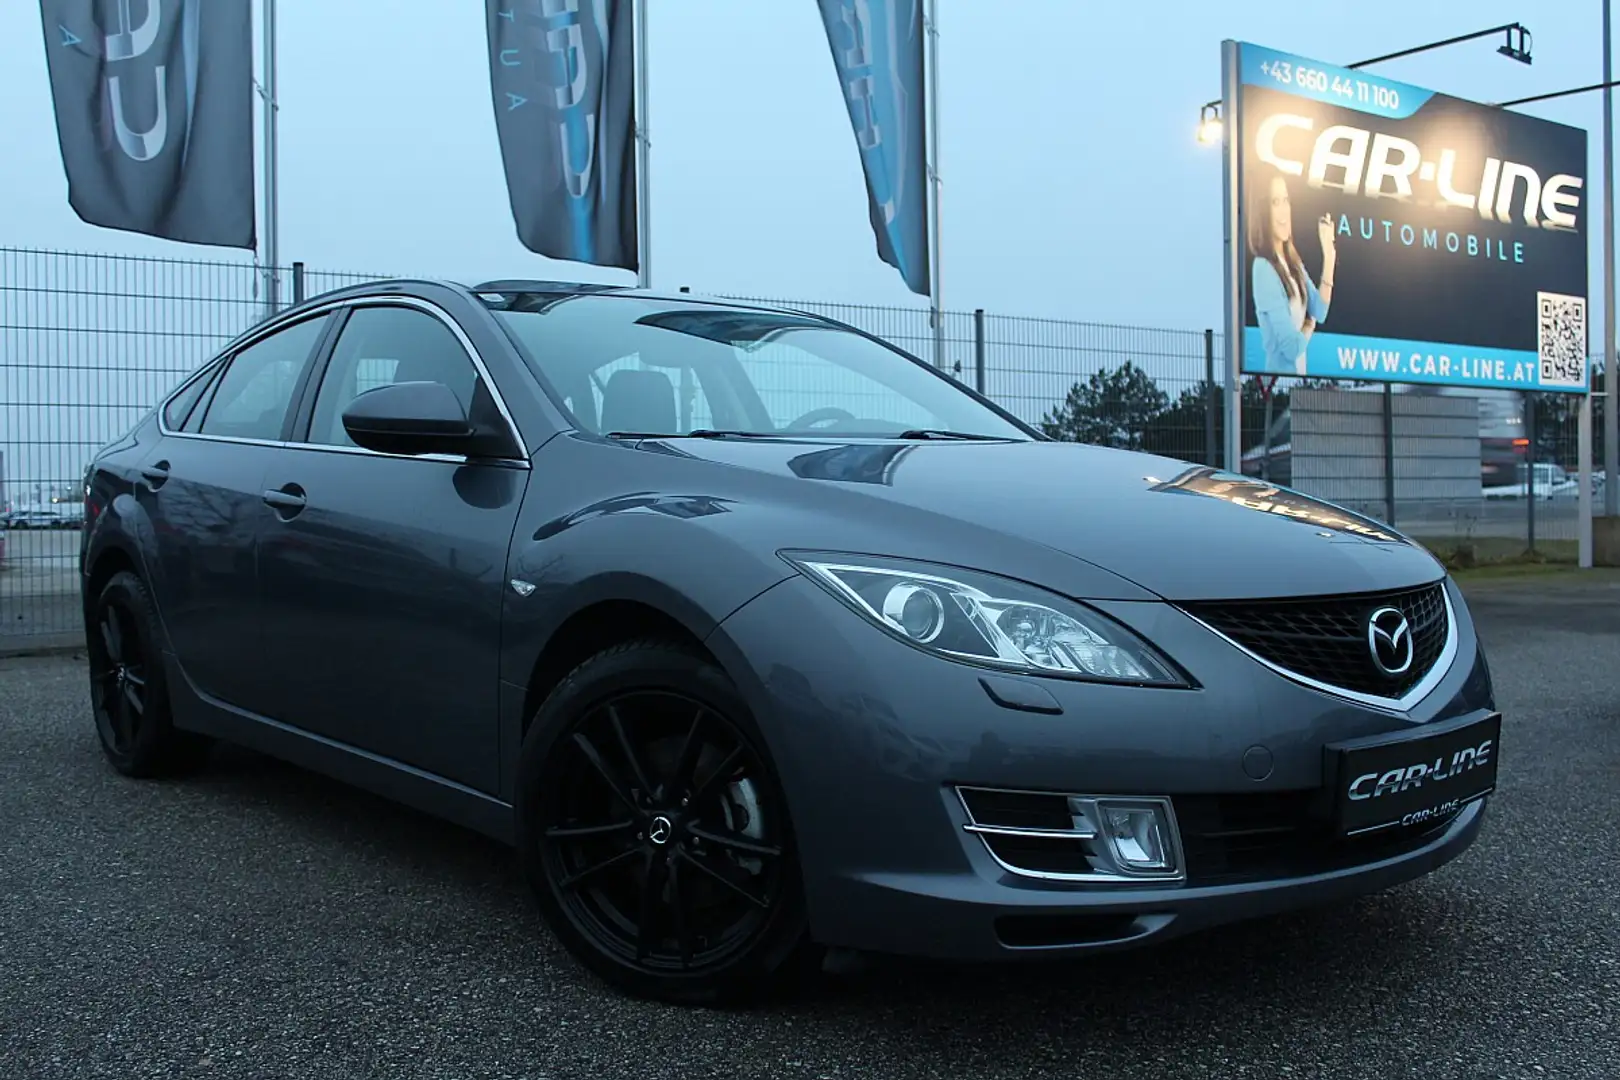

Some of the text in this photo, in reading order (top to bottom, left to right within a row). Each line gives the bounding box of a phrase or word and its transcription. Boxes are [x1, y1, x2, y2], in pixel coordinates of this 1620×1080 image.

[1261, 61, 1399, 110] +43 660 44 11 100
[1338, 214, 1524, 263] AUTOMOBILE
[1337, 347, 1534, 382] WWW.CAR-LINE.AT
[1348, 740, 1492, 800] CAR-LINE
